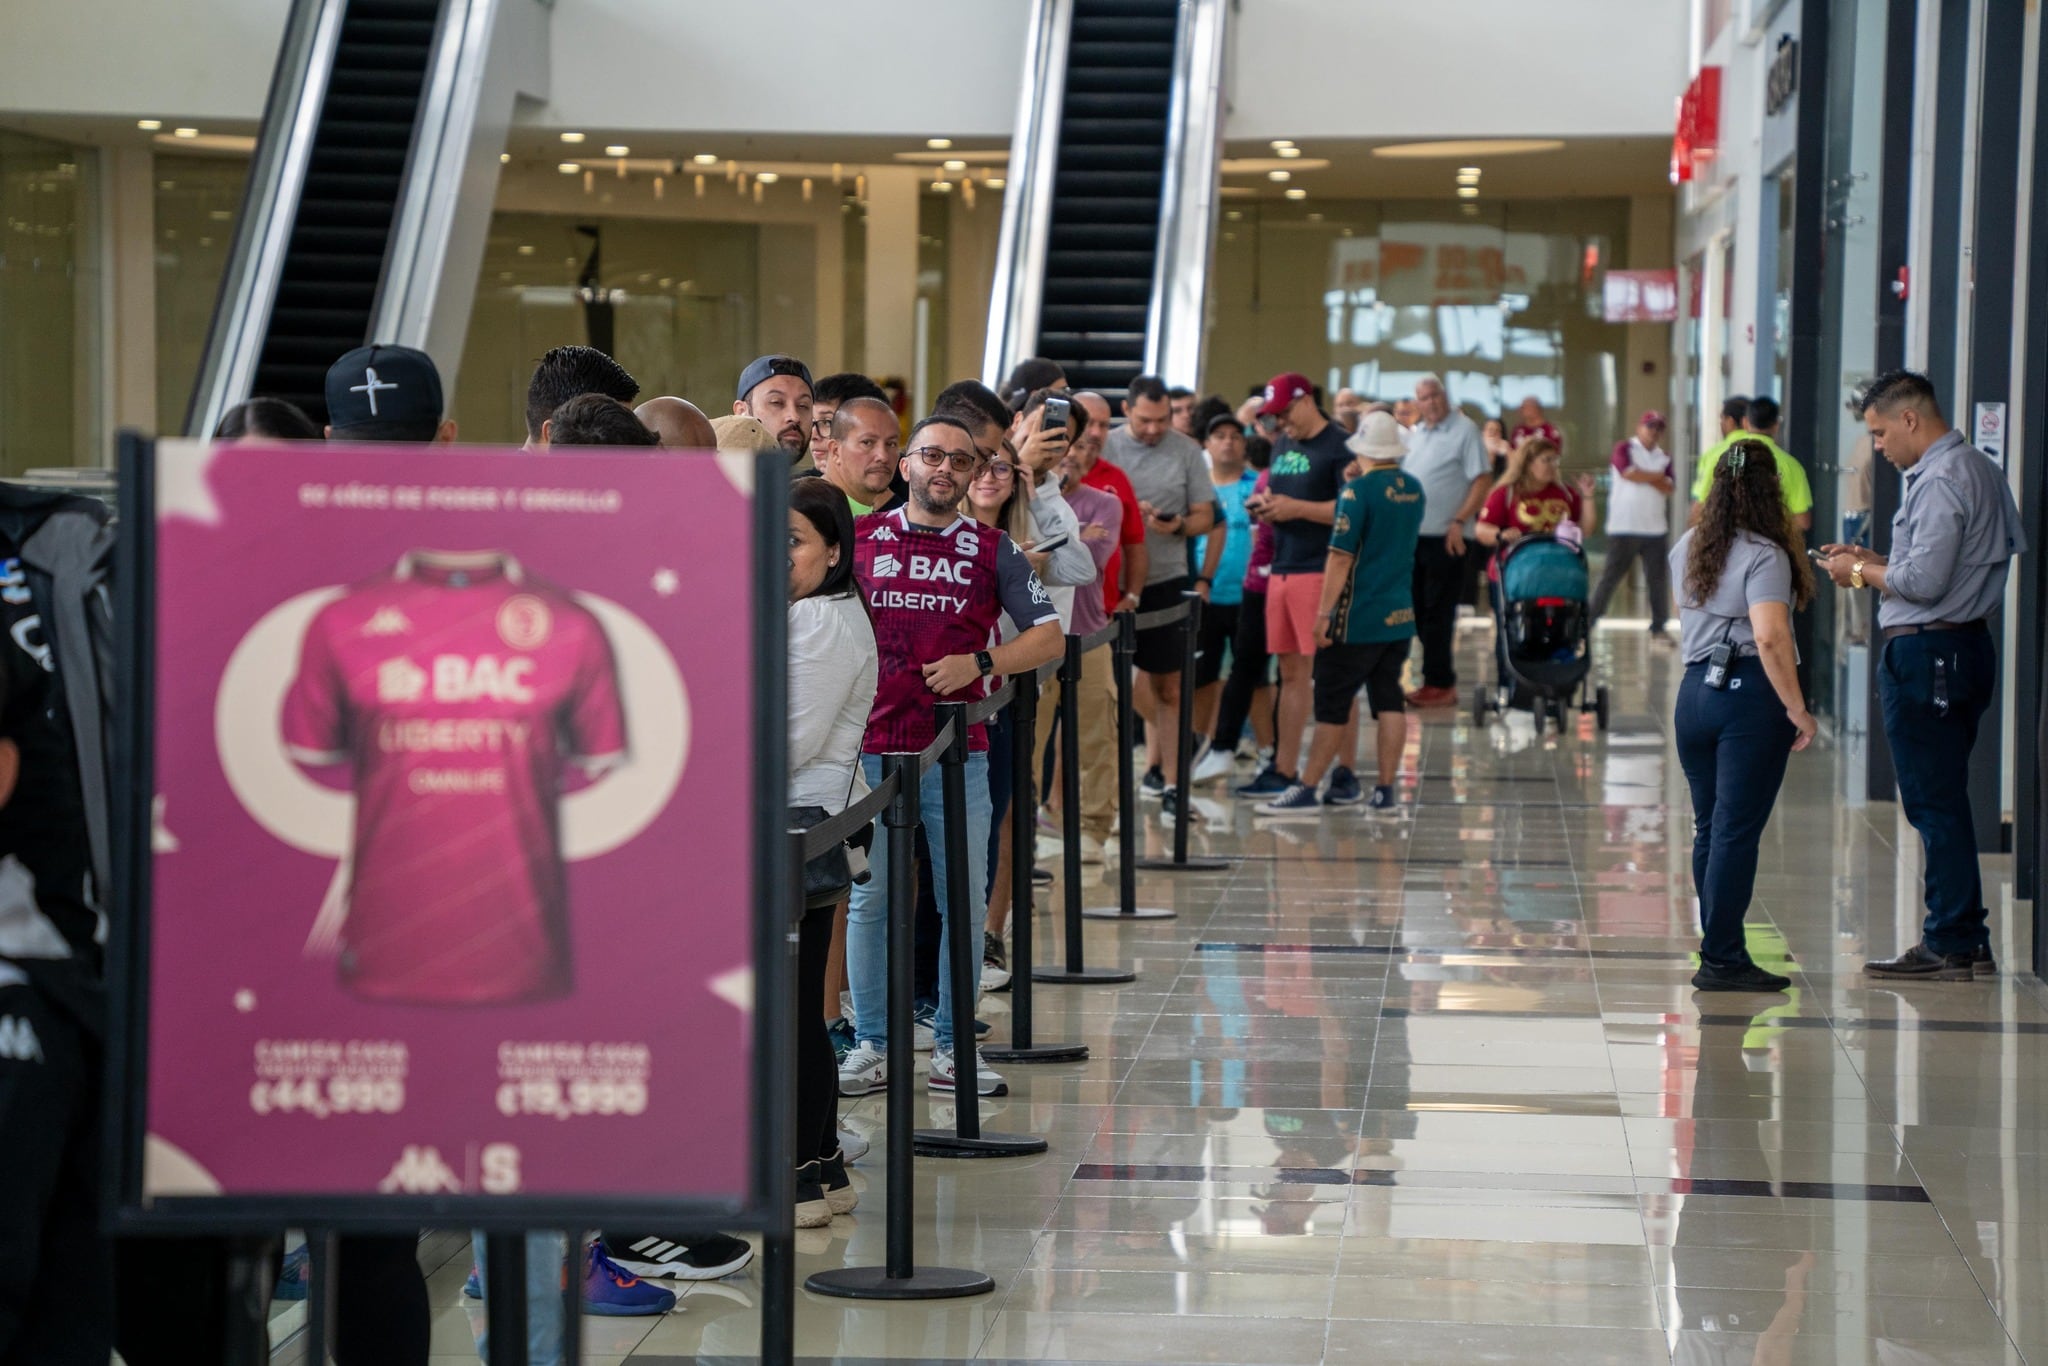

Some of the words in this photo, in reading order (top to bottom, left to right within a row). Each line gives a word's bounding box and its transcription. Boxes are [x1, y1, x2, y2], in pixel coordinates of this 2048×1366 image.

[393, 485, 422, 509] DE
[954, 530, 979, 557] S
[909, 555, 973, 585] BAC
[870, 590, 968, 614] LIBERTY
[433, 654, 536, 703] BAC
[378, 719, 532, 752] LIBERTY
[480, 1142, 521, 1195] S
